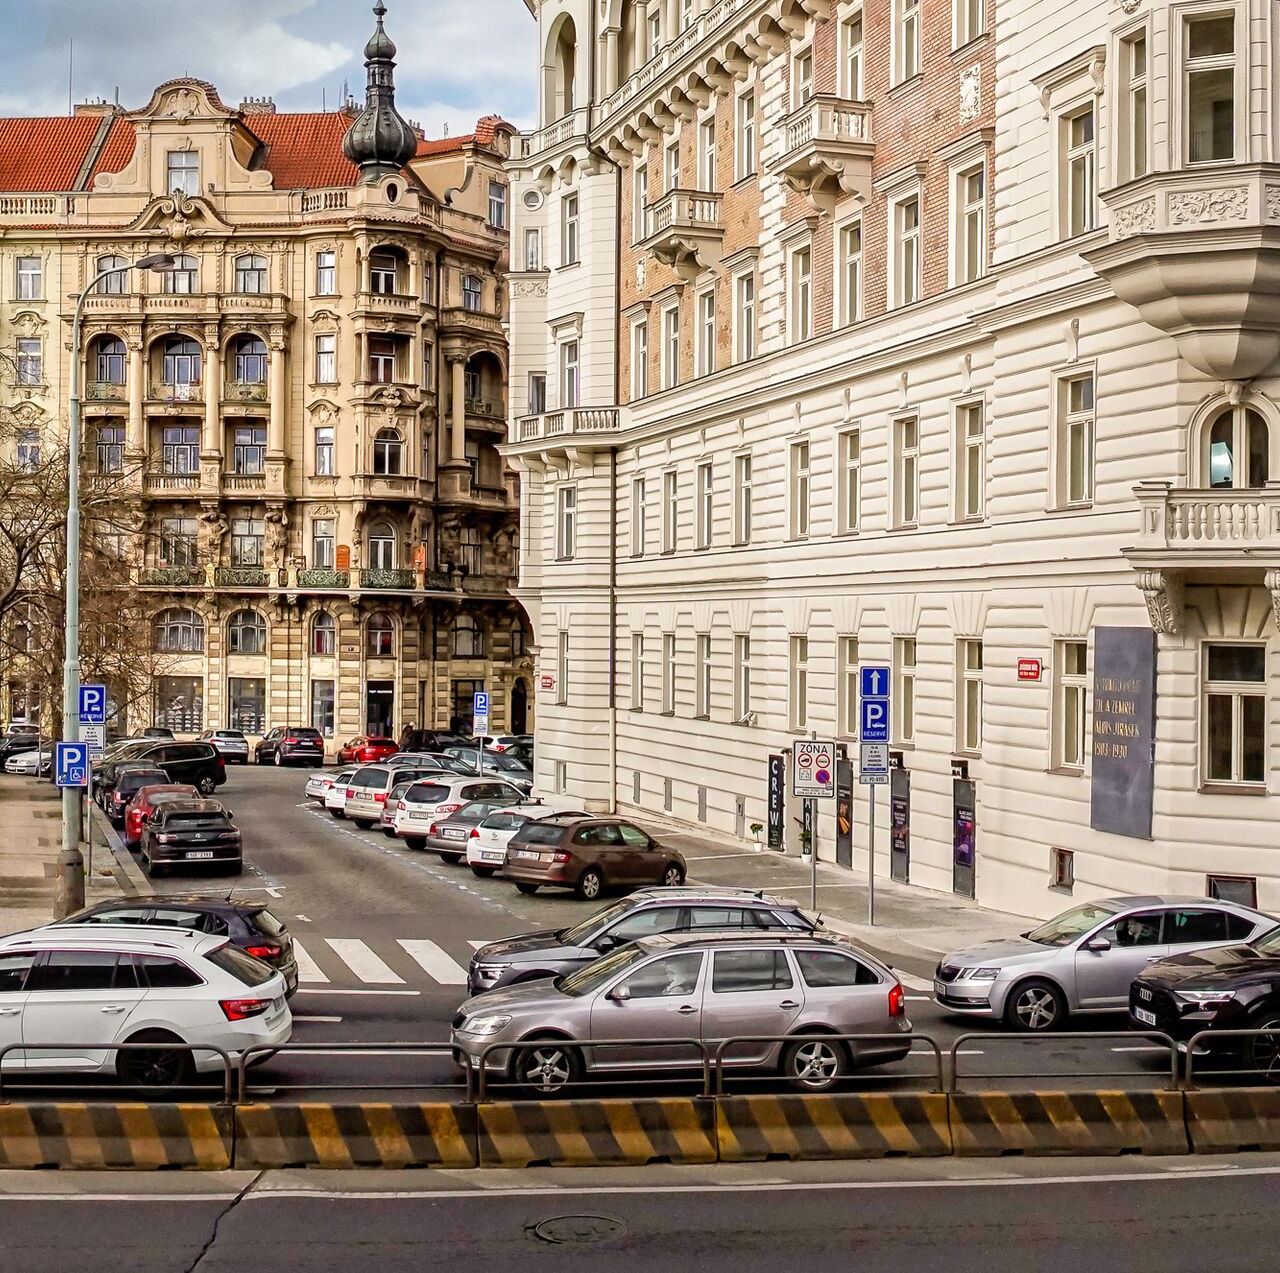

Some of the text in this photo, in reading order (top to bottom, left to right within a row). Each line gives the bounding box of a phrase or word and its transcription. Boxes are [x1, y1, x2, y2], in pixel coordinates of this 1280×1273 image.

[83, 689, 100, 712] P
[476, 695, 485, 709] P
[866, 704, 883, 729] P
[62, 747, 81, 773] P
[800, 742, 829, 754] ZÓNA
[769, 759, 780, 826] CREW
